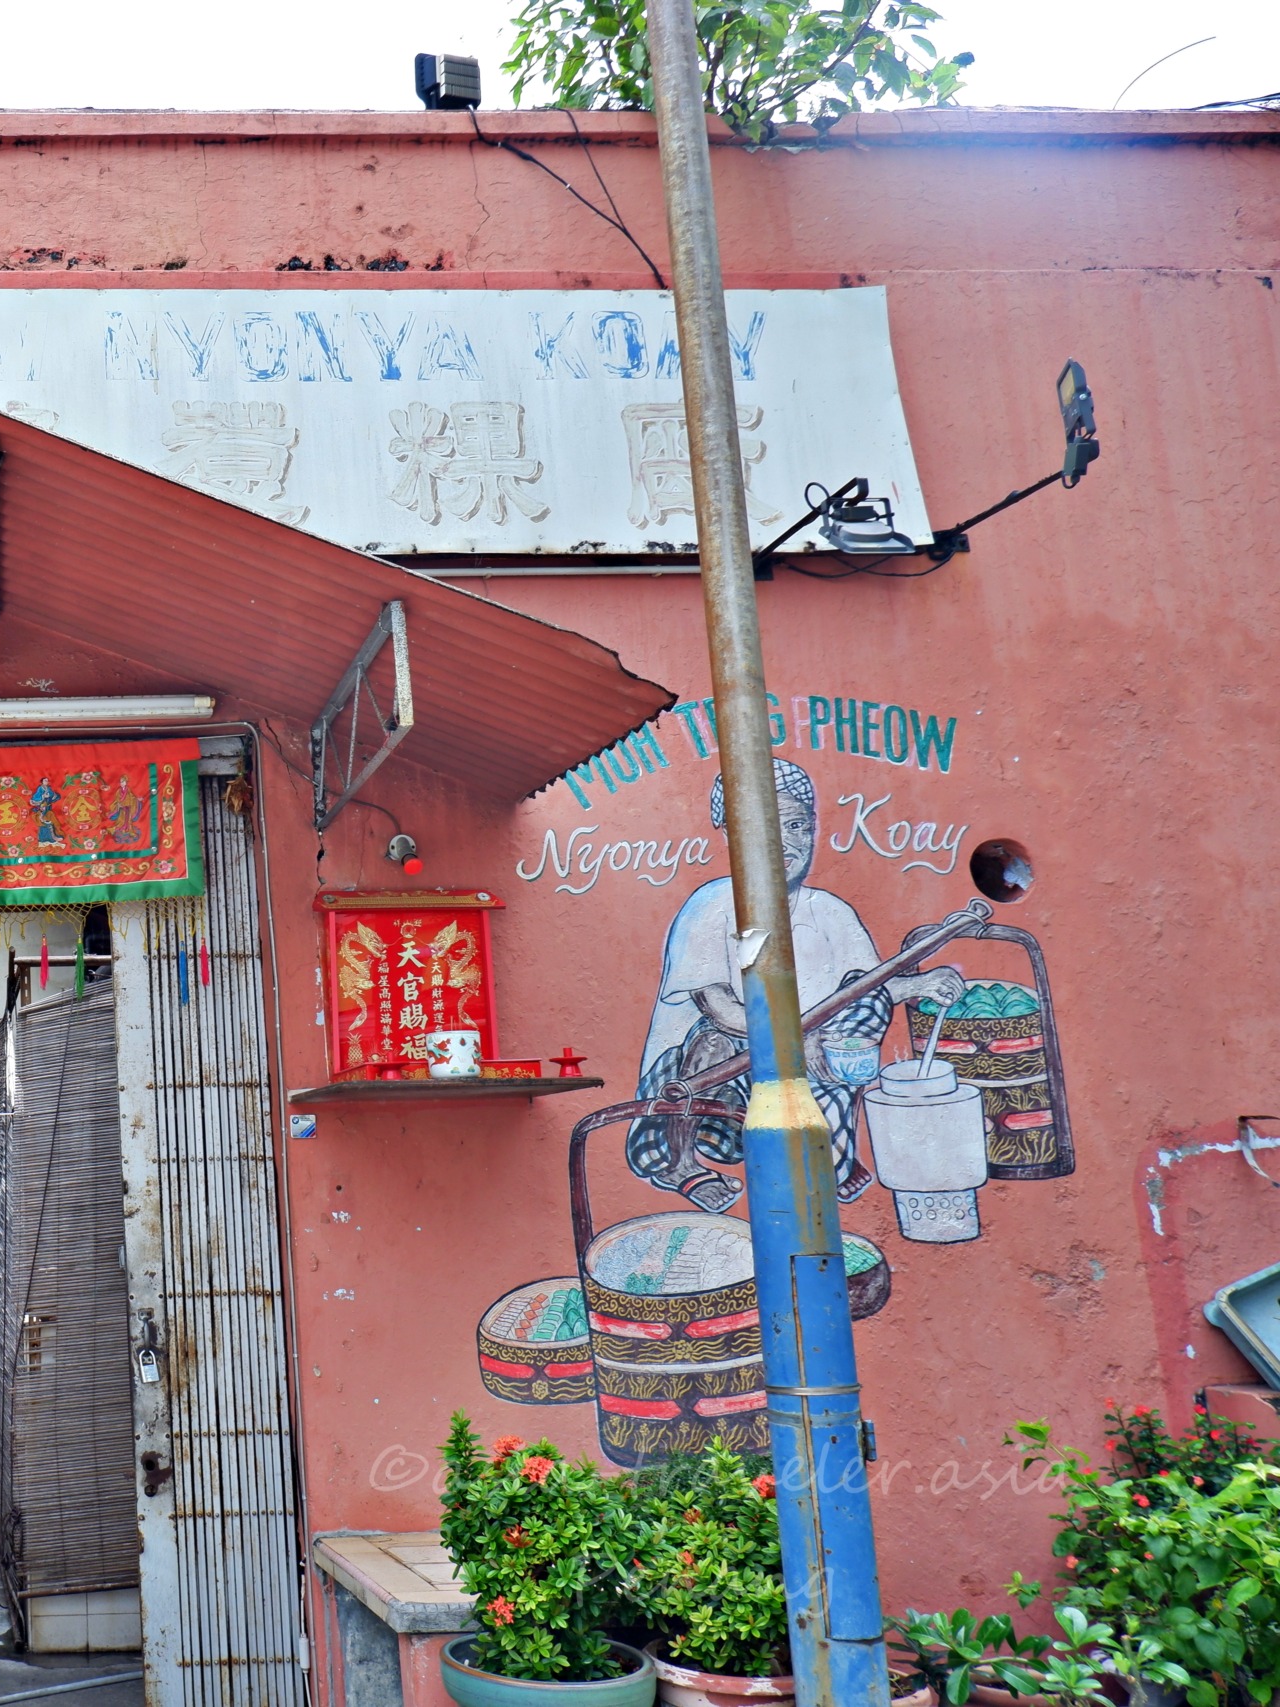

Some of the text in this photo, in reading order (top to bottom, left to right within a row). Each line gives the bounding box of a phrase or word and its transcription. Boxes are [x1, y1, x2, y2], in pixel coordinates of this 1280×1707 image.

[105, 310, 484, 382] NYONYA
[672, 692, 787, 760] TG
[807, 695, 959, 775] PHEOW
[516, 793, 969, 895] Nyonya Koay
[397, 940, 429, 1060] 天官賜福
